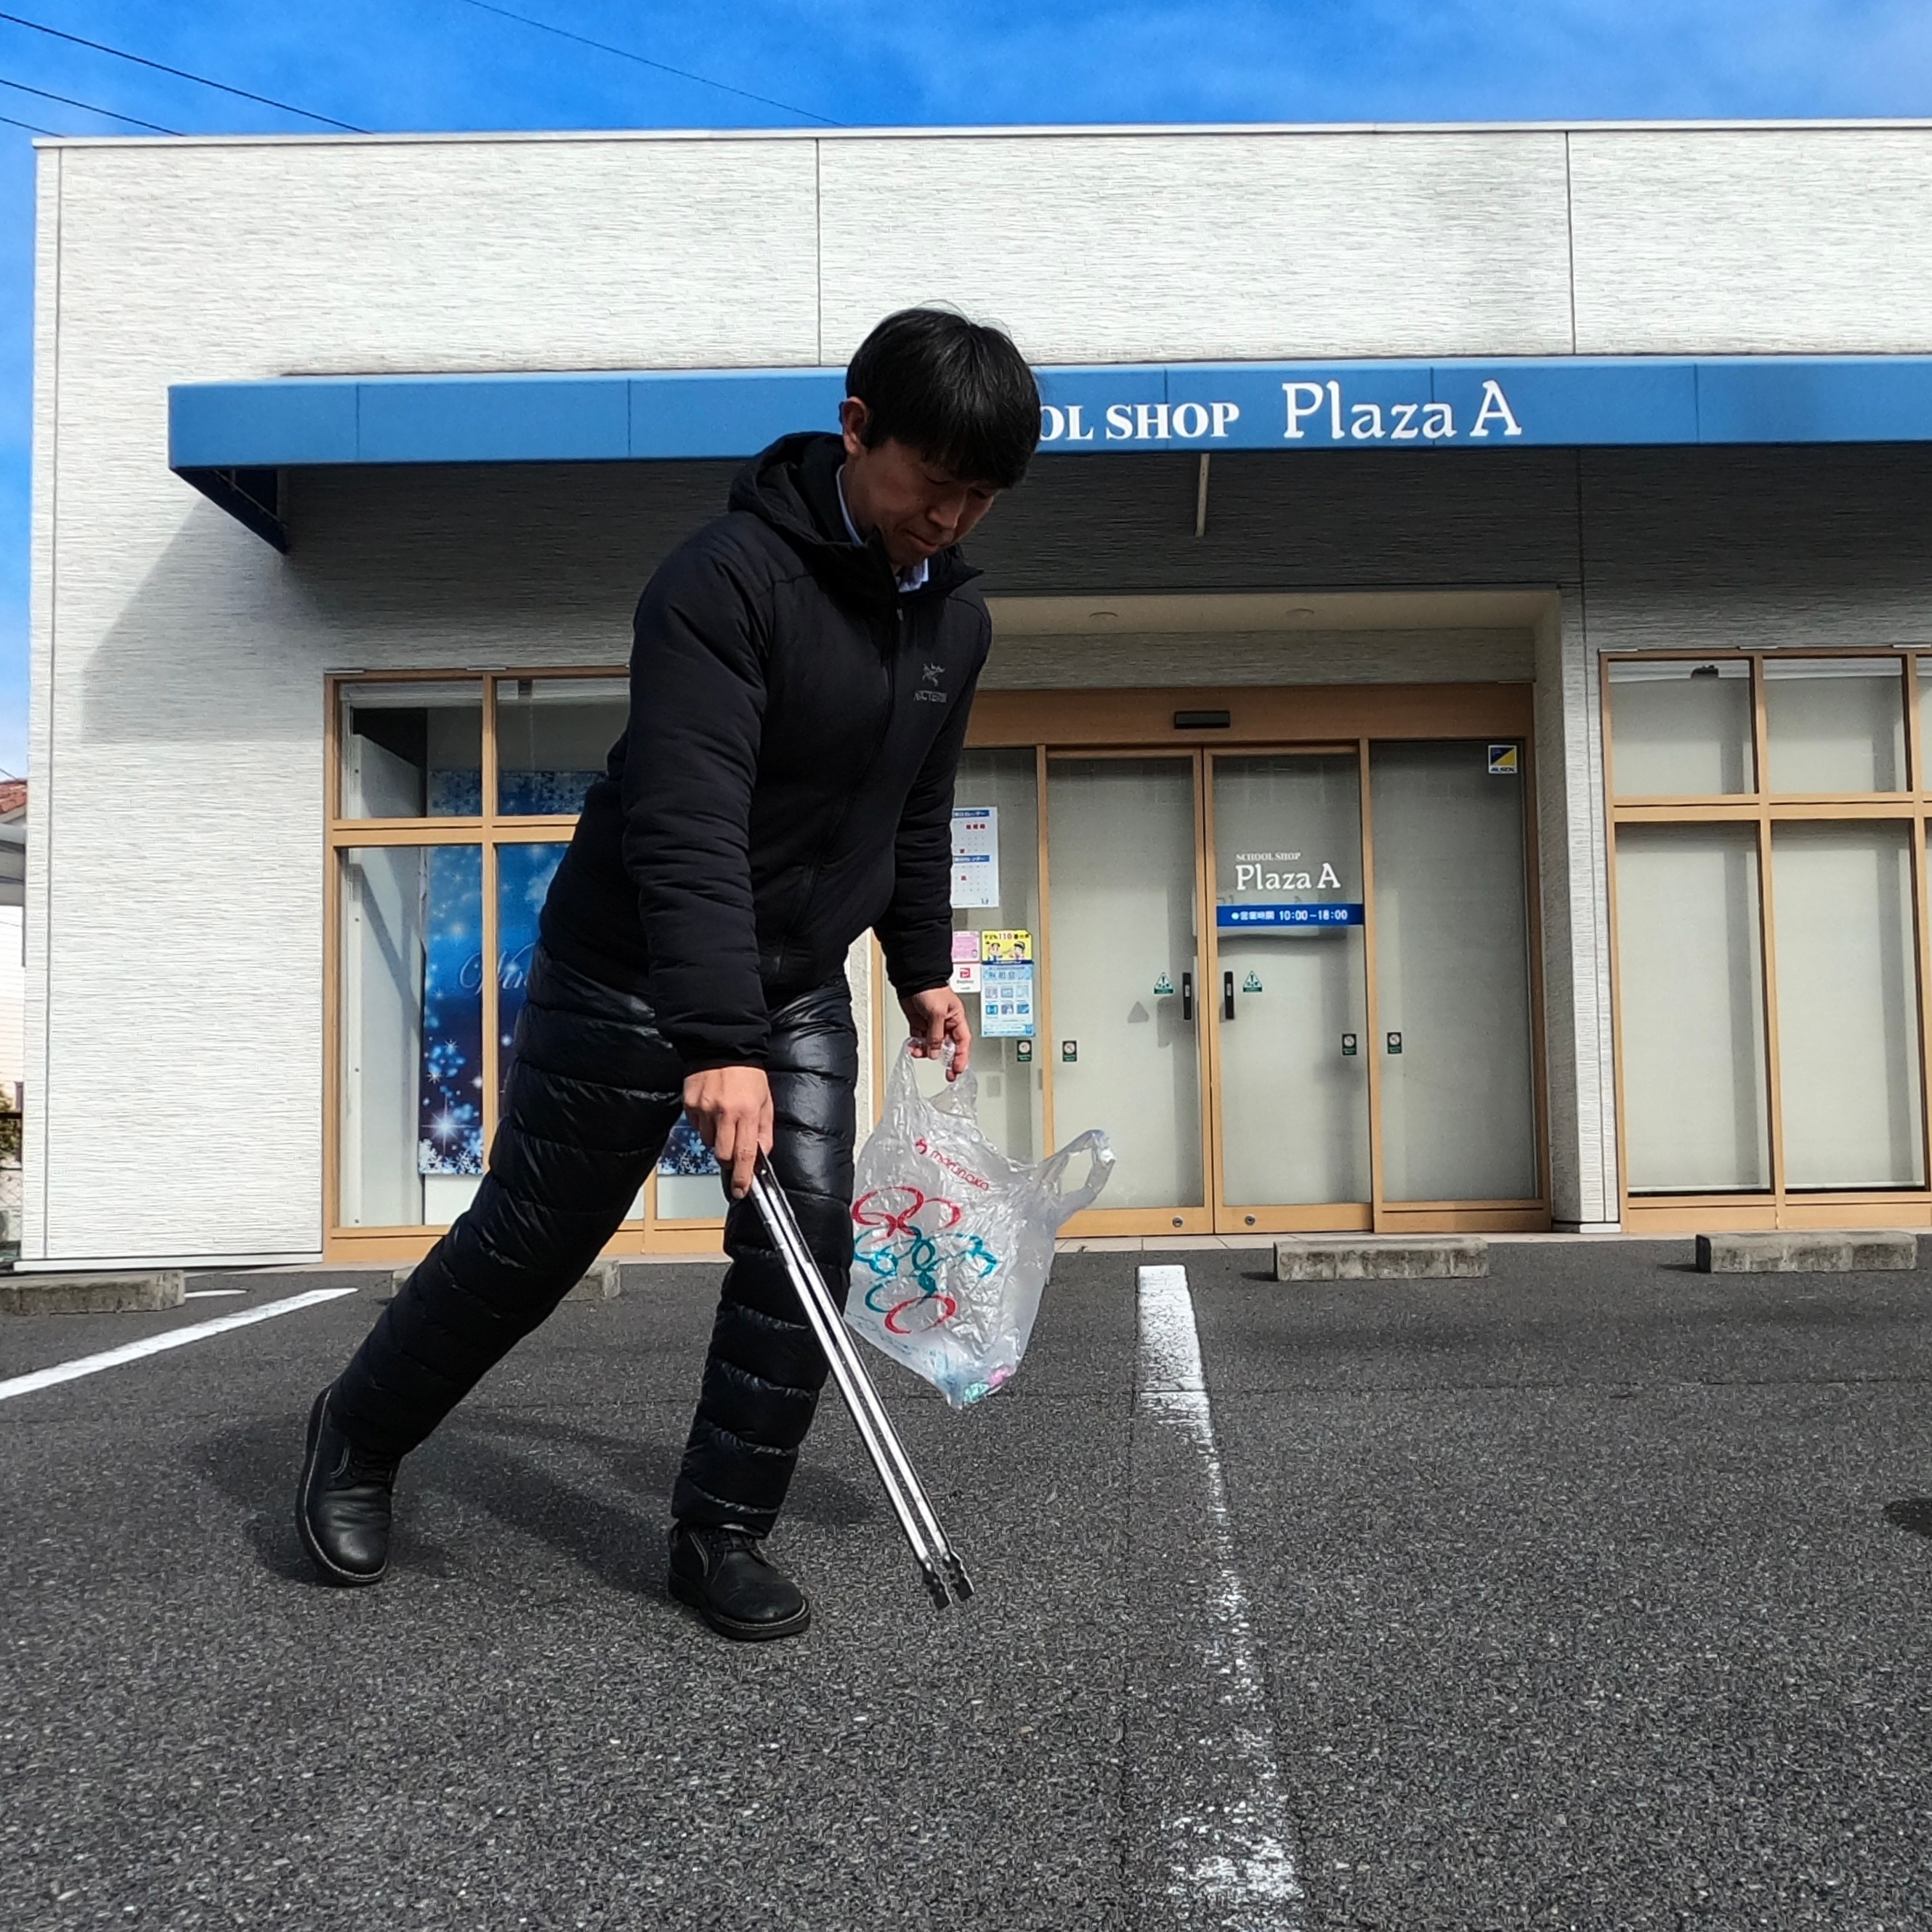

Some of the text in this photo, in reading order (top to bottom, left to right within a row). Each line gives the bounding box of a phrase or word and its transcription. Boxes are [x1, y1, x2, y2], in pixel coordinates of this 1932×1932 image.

[1105, 402, 1240, 440] SHOP
[1282, 379, 1457, 440] Plaza
[1469, 379, 1522, 437] A
[1236, 852, 1301, 861] SCHOOL SHOP
[1235, 862, 1341, 891] Plaza A
[930, 1150, 990, 1191] marunaka
